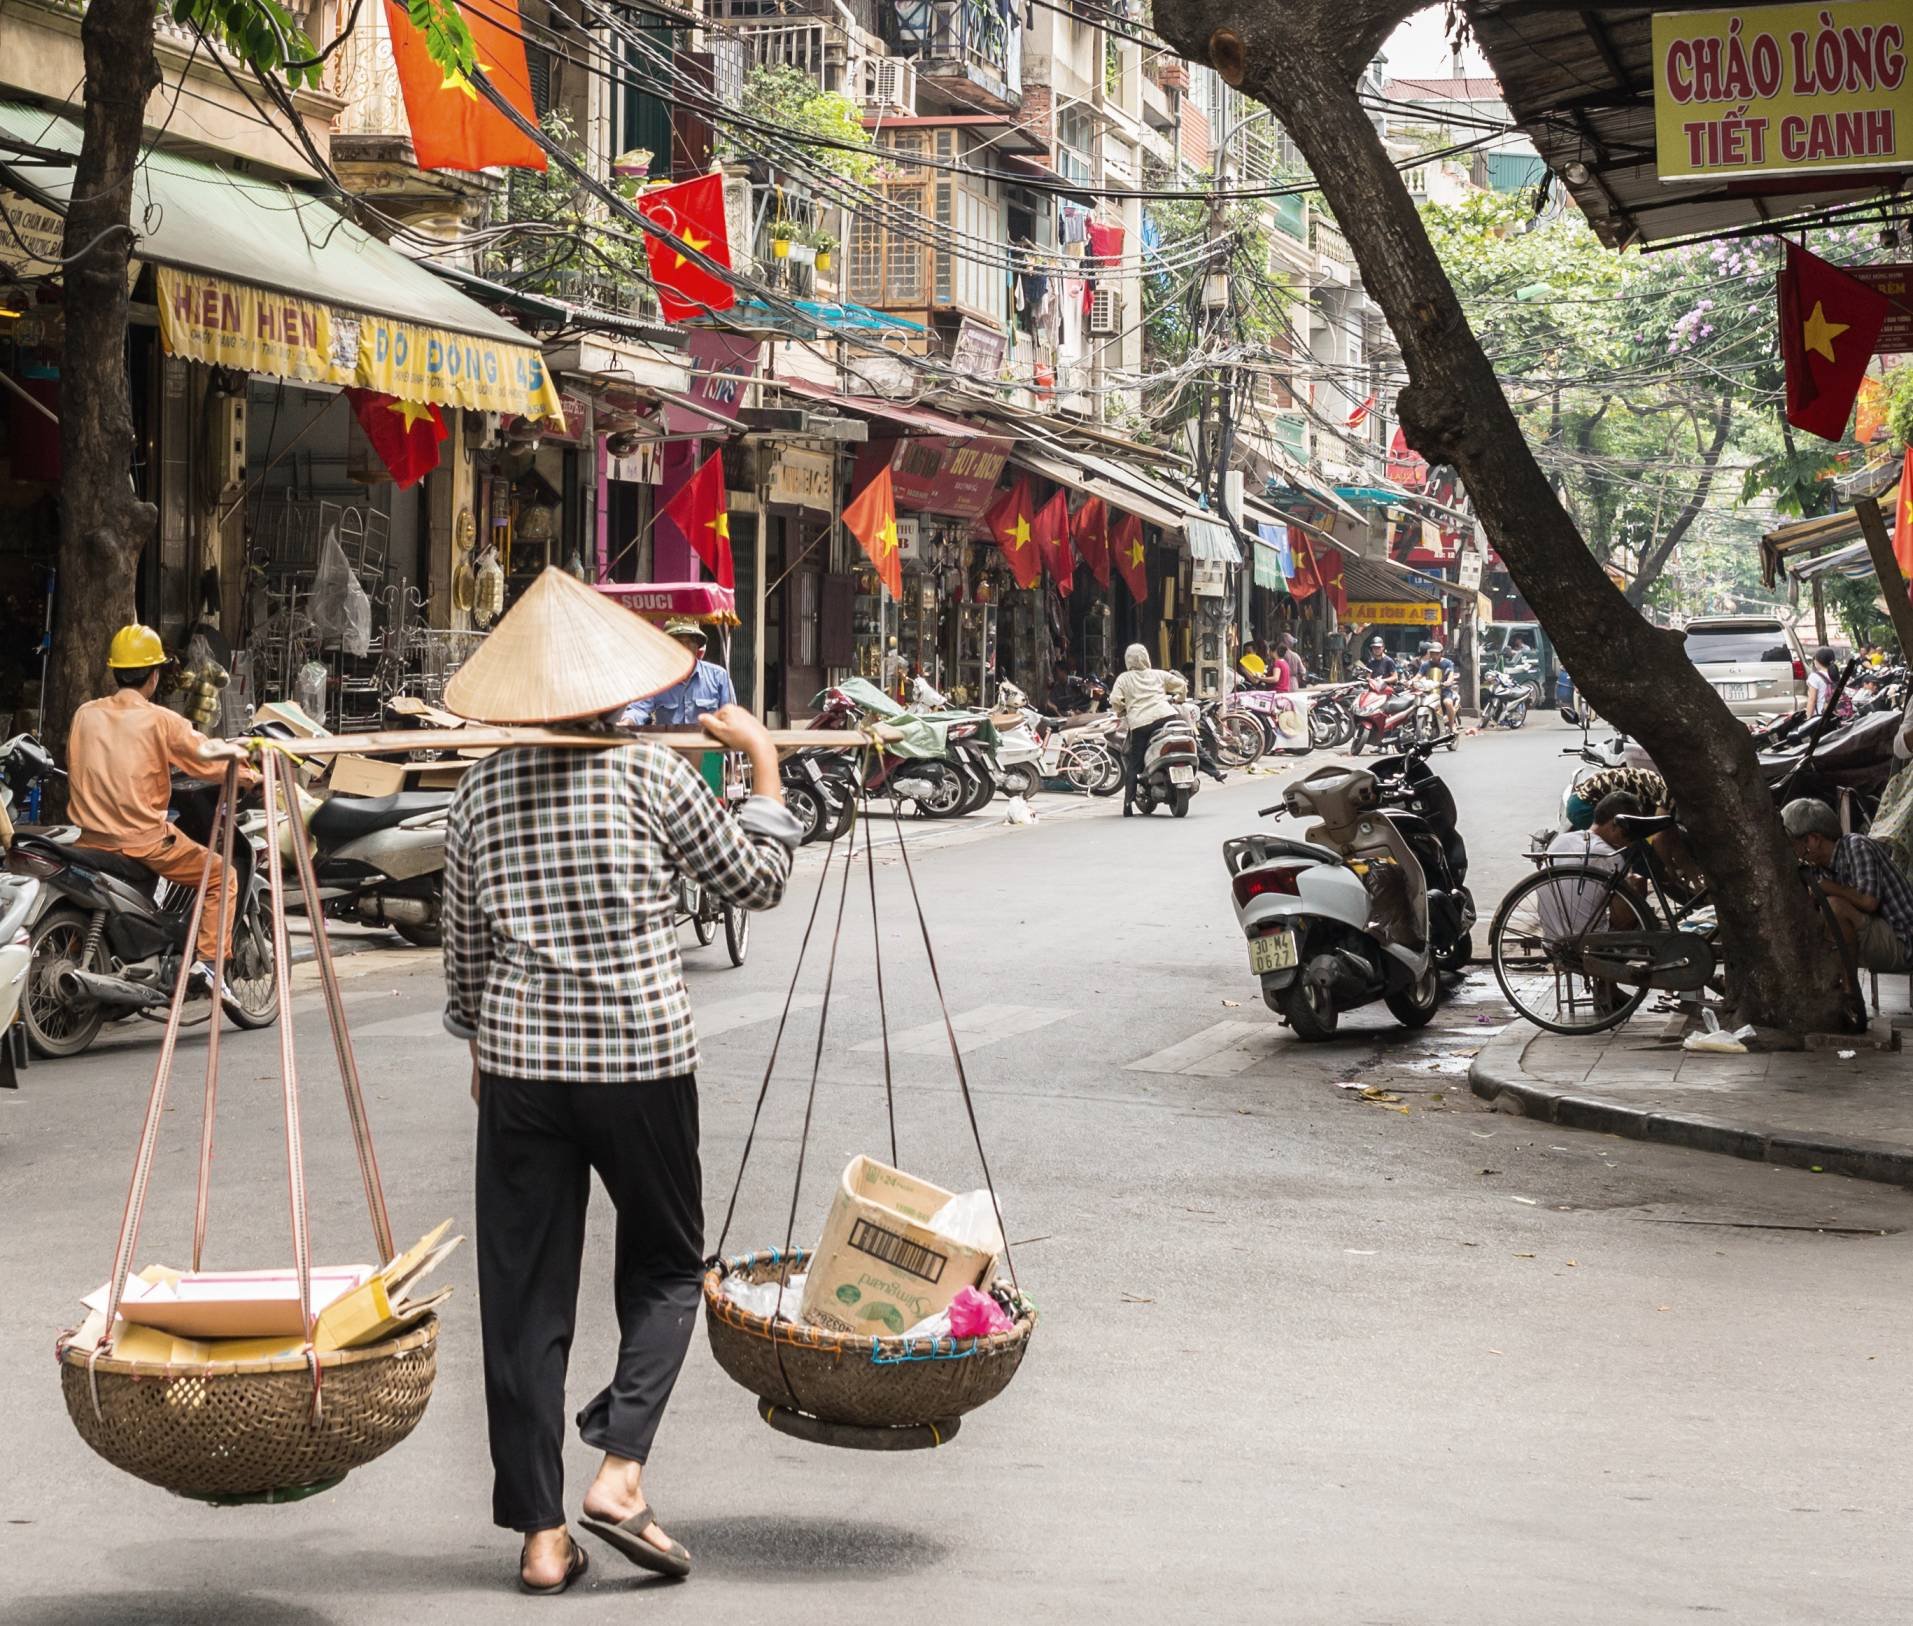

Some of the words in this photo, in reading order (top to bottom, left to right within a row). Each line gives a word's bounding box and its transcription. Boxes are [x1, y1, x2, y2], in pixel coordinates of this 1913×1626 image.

[1667, 17, 1781, 104] CHÁO
[1790, 11, 1905, 94] LÒNG
[1684, 105, 1769, 167] TIẾT
[1781, 109, 1895, 160] CANH
[622, 593, 673, 610] SOUCI
[1256, 949, 1289, 971] 0627
[858, 1271, 932, 1320] Slimguard
